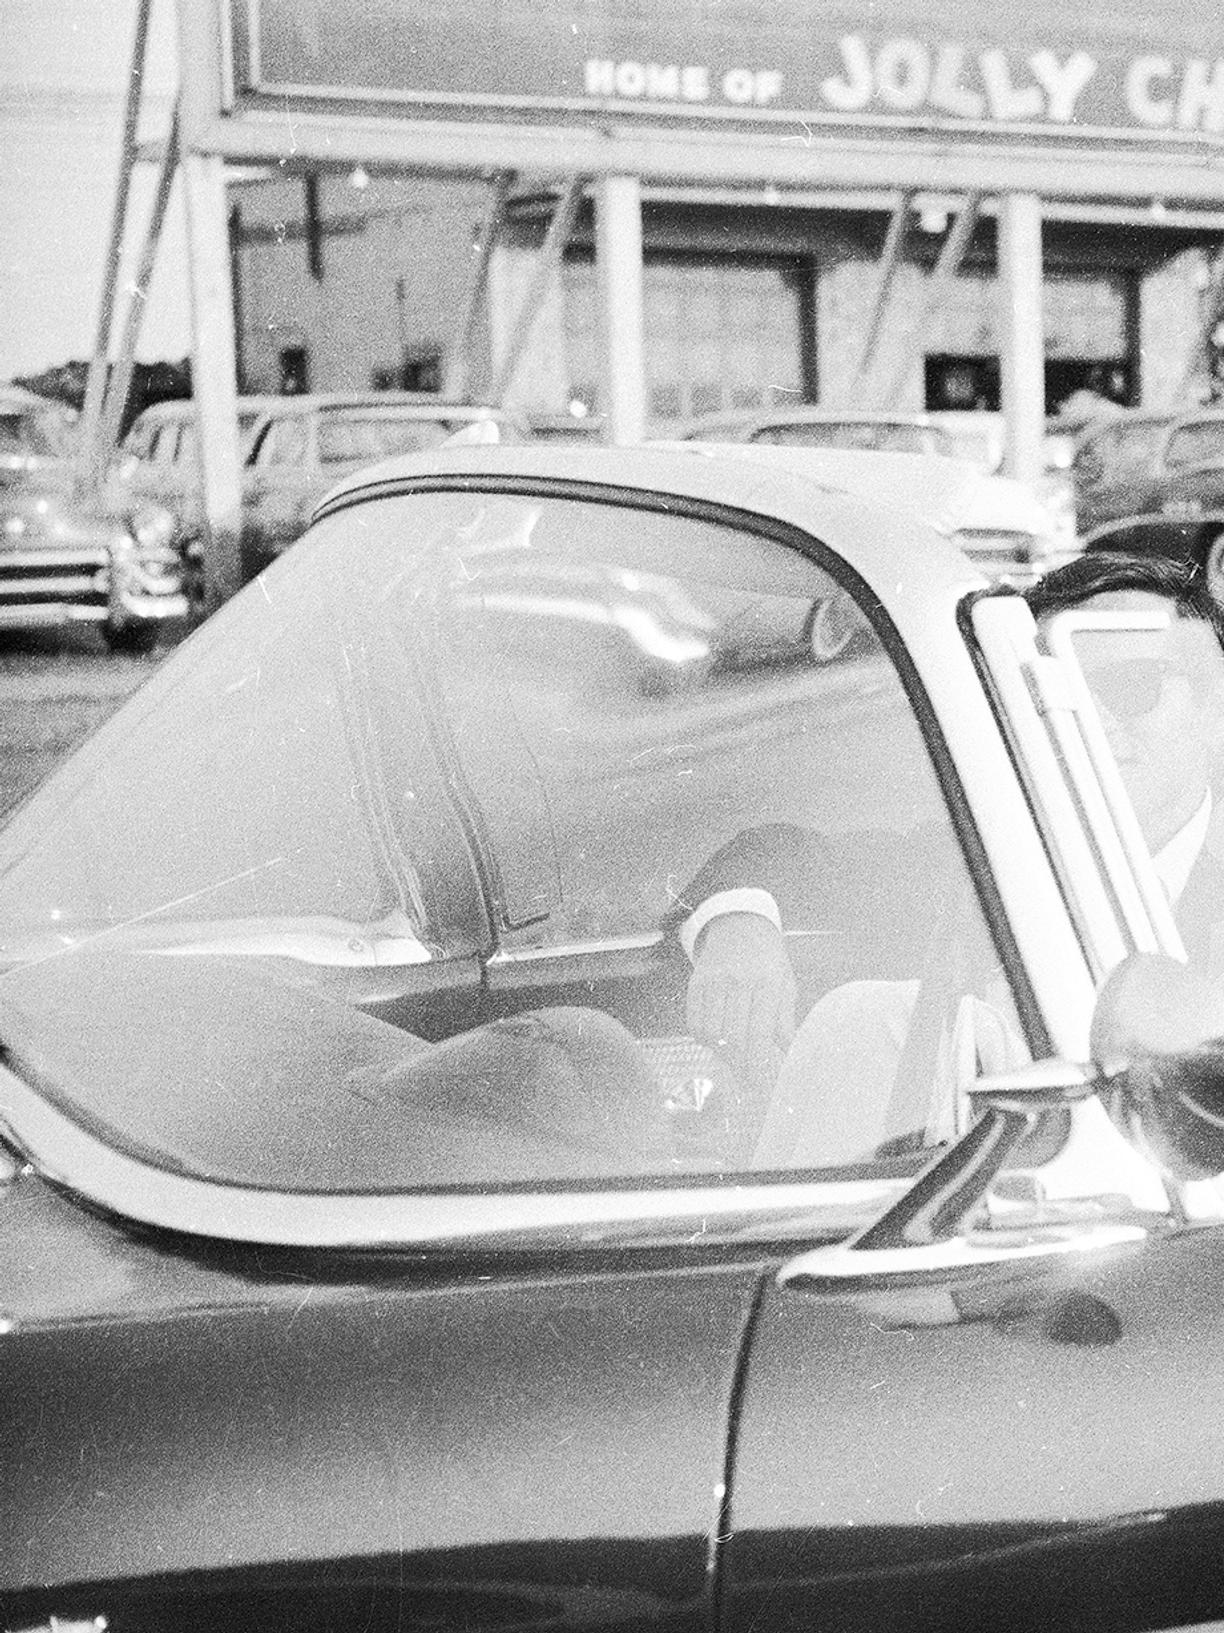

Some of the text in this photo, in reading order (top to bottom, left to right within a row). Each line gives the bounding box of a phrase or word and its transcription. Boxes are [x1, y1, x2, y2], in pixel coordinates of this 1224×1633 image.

[585, 58, 709, 101] HOME
[722, 68, 783, 103] OF
[820, 34, 1096, 122] JOLLY
